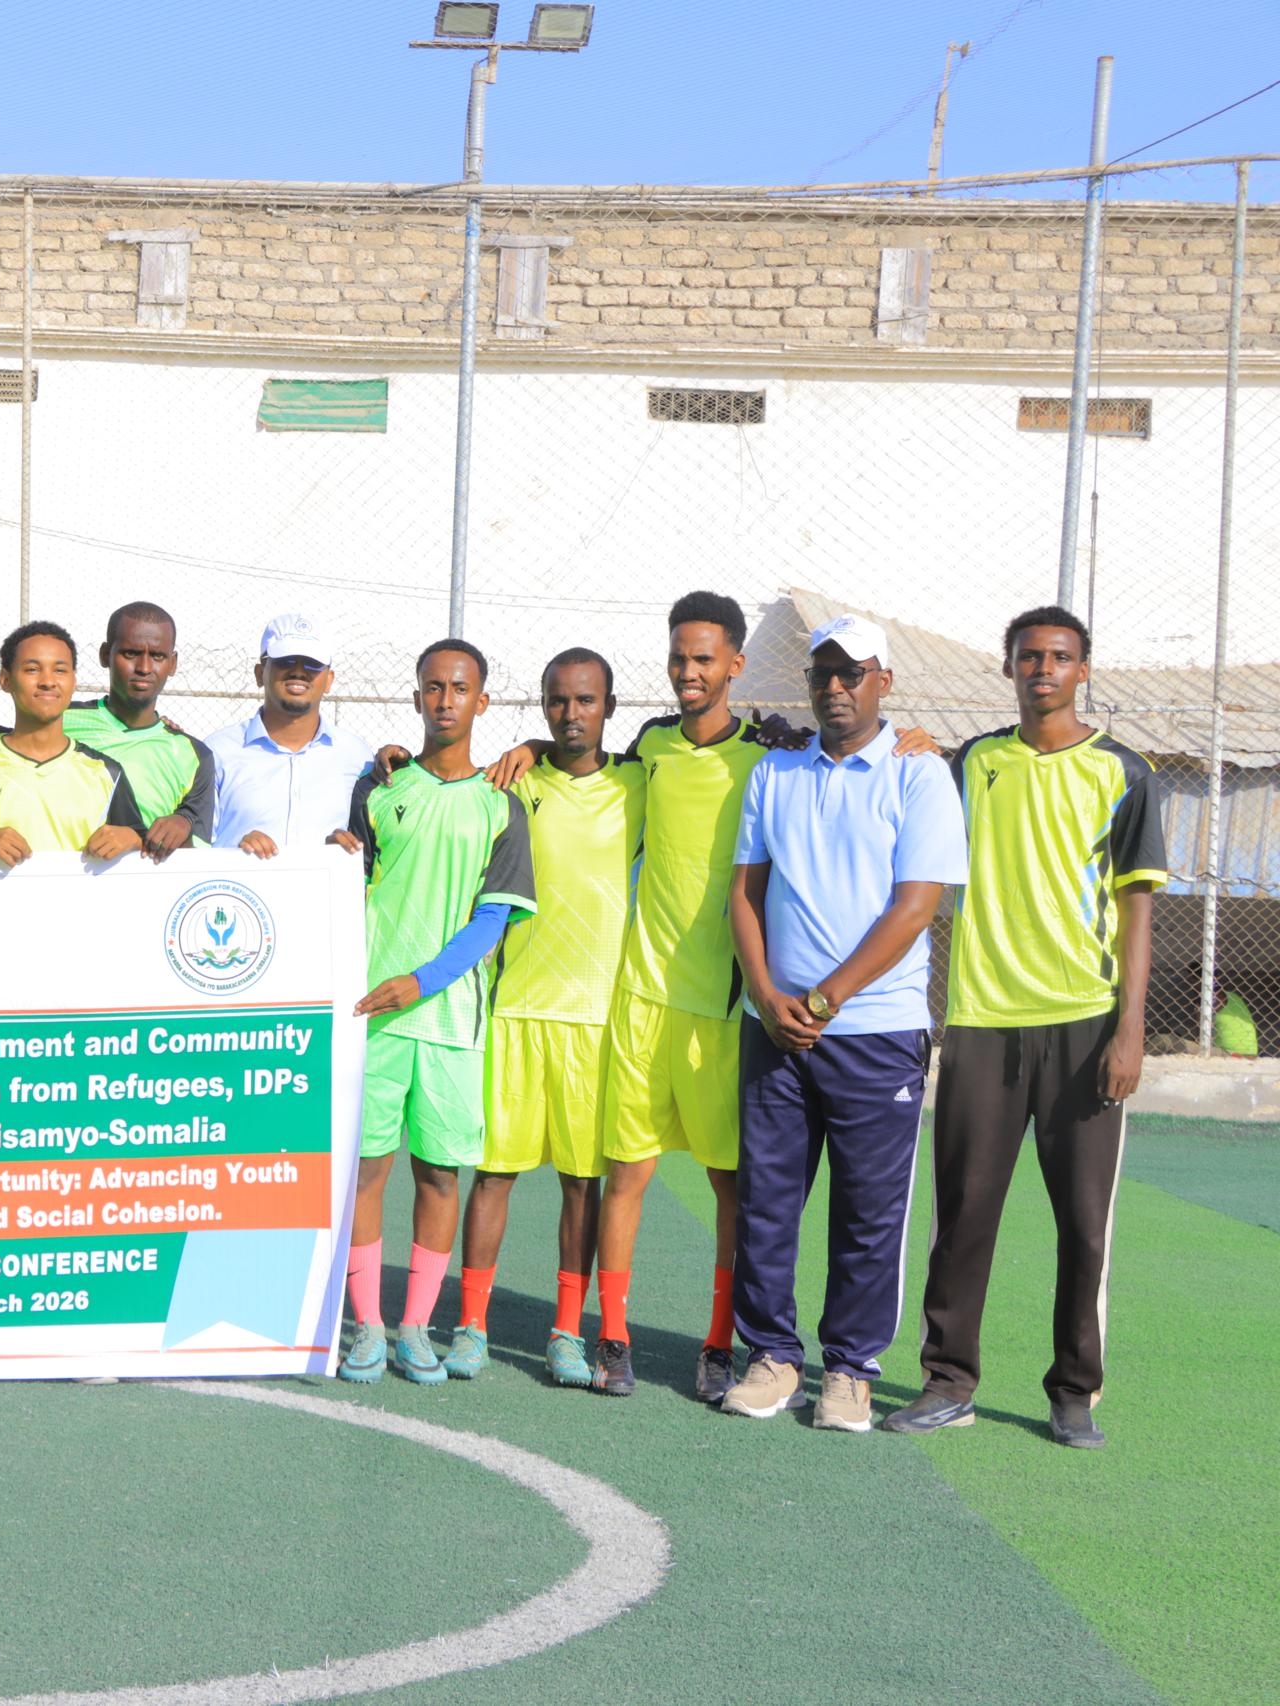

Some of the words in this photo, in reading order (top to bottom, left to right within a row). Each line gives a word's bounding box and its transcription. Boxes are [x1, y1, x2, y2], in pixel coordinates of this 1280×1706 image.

[83, 1028, 139, 1057] and
[147, 1023, 313, 1056] Community
[8, 1076, 78, 1103] from
[87, 1072, 234, 1105] Refugees,
[243, 1068, 309, 1096] IDPs
[88, 1163, 218, 1191] Advancing
[224, 1160, 299, 1185] Youth
[15, 1203, 94, 1229] Social
[101, 1199, 223, 1225] Cohesion.
[30, 1289, 90, 1312] 2026
